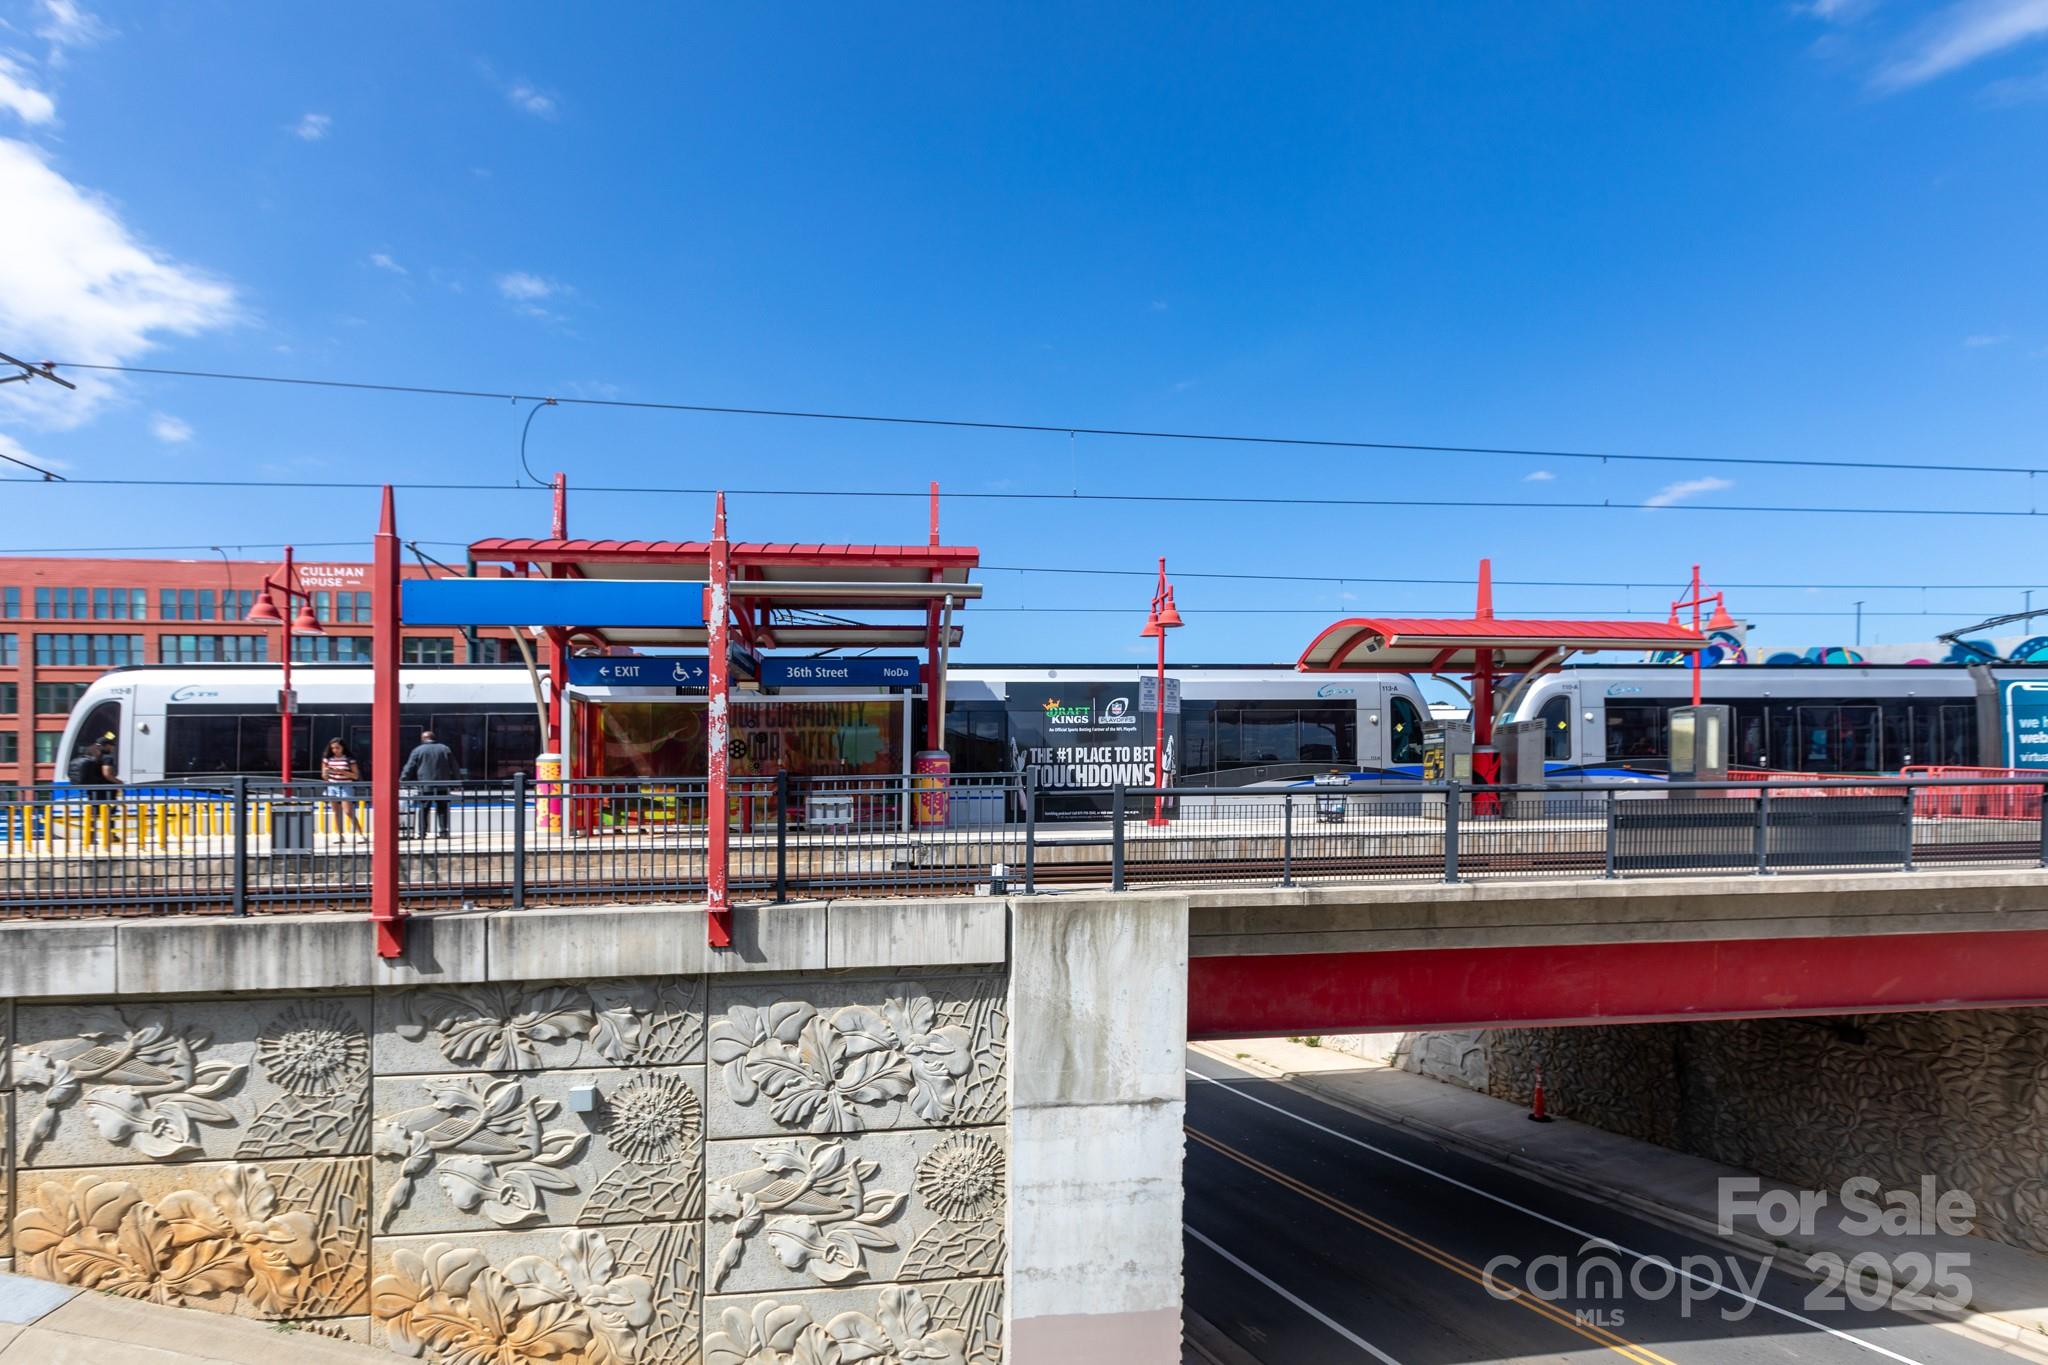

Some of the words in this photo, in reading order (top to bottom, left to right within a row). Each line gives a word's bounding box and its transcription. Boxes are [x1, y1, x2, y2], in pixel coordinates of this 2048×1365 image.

[300, 566, 364, 577] CULLMAN
[301, 577, 343, 587] HOUSE
[614, 666, 640, 677] EXIT
[786, 666, 812, 678] 36th
[815, 667, 849, 678] Street
[883, 668, 909, 677] NoDa
[1047, 707, 1090, 717] DRAFT
[1052, 715, 1089, 724] KINGS
[2019, 718, 2040, 728] we
[1030, 748, 1053, 763] THE
[1056, 747, 1072, 763] #1
[1075, 747, 1112, 763] PLACE
[1115, 747, 1131, 762] TO
[1133, 747, 1155, 762] BET
[1027, 763, 1155, 787] TOUCHDOWNS
